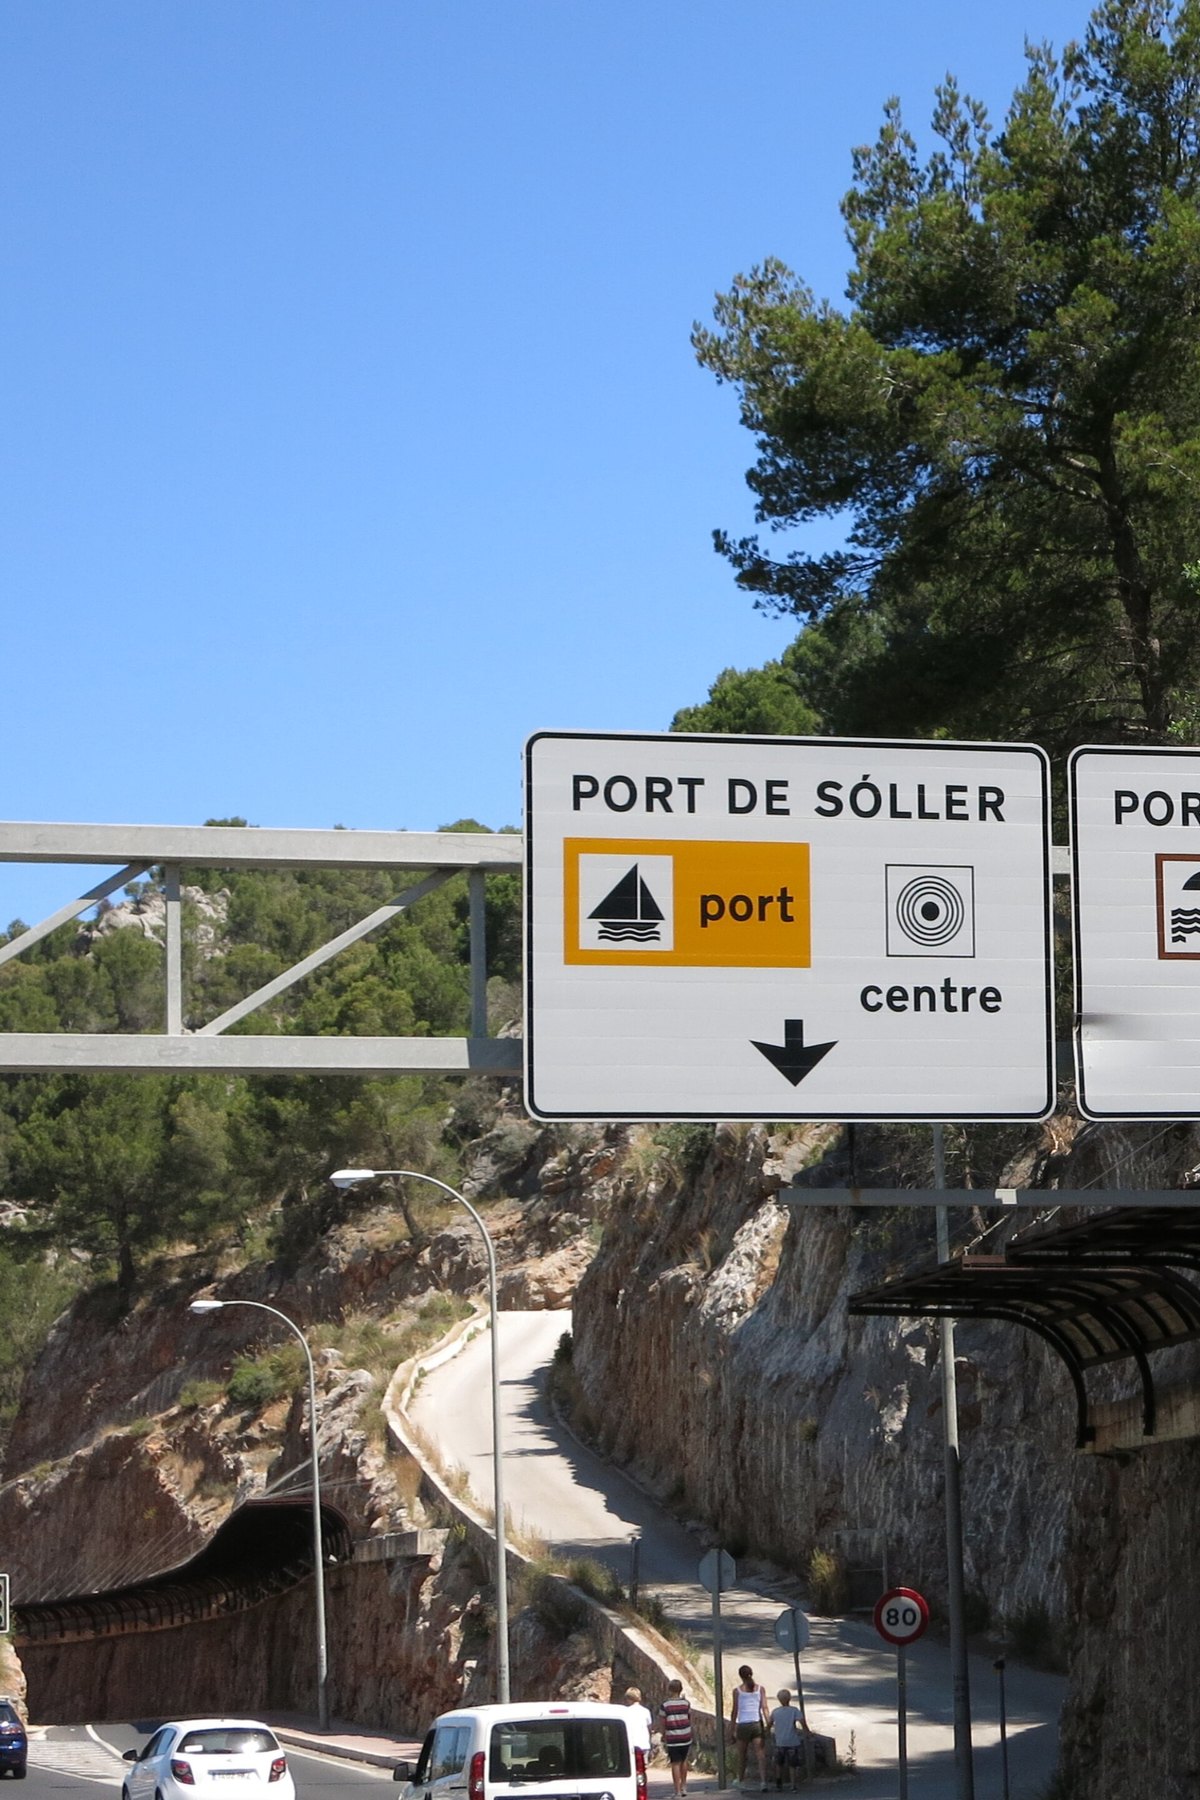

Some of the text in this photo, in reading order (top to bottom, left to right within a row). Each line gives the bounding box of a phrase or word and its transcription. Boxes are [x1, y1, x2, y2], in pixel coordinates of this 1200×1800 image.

[572, 773, 1006, 823] PORT DE SÓLLER
[699, 886, 796, 929] port
[859, 976, 1003, 1014] centre
[886, 1607, 917, 1627] 80
